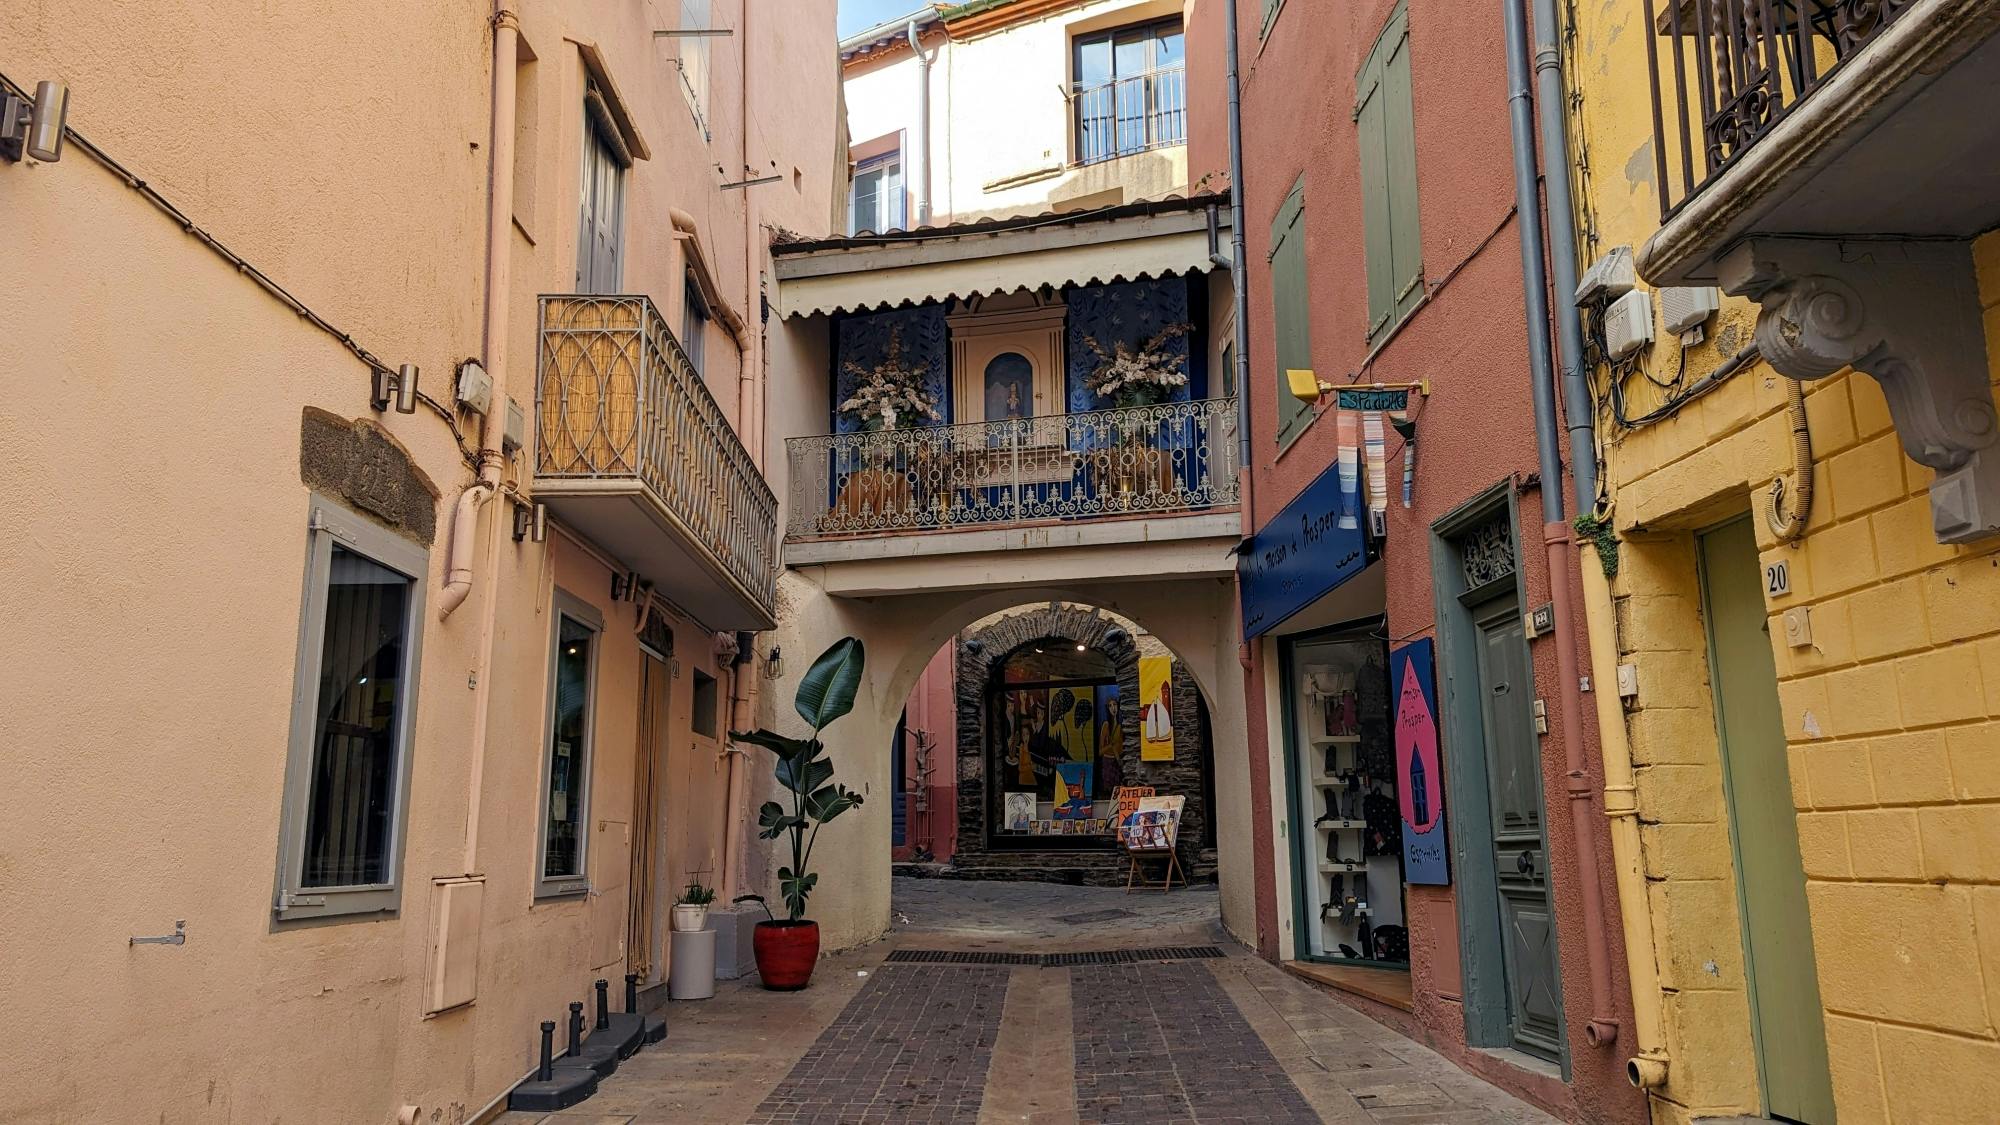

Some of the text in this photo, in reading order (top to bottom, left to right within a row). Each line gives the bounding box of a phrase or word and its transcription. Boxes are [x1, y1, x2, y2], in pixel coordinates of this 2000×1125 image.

[1302, 511, 1335, 549] Prosper
[1768, 564, 1787, 592] 20
[1537, 612, 1546, 625] 22
[1120, 788, 1153, 799] ATELIER
